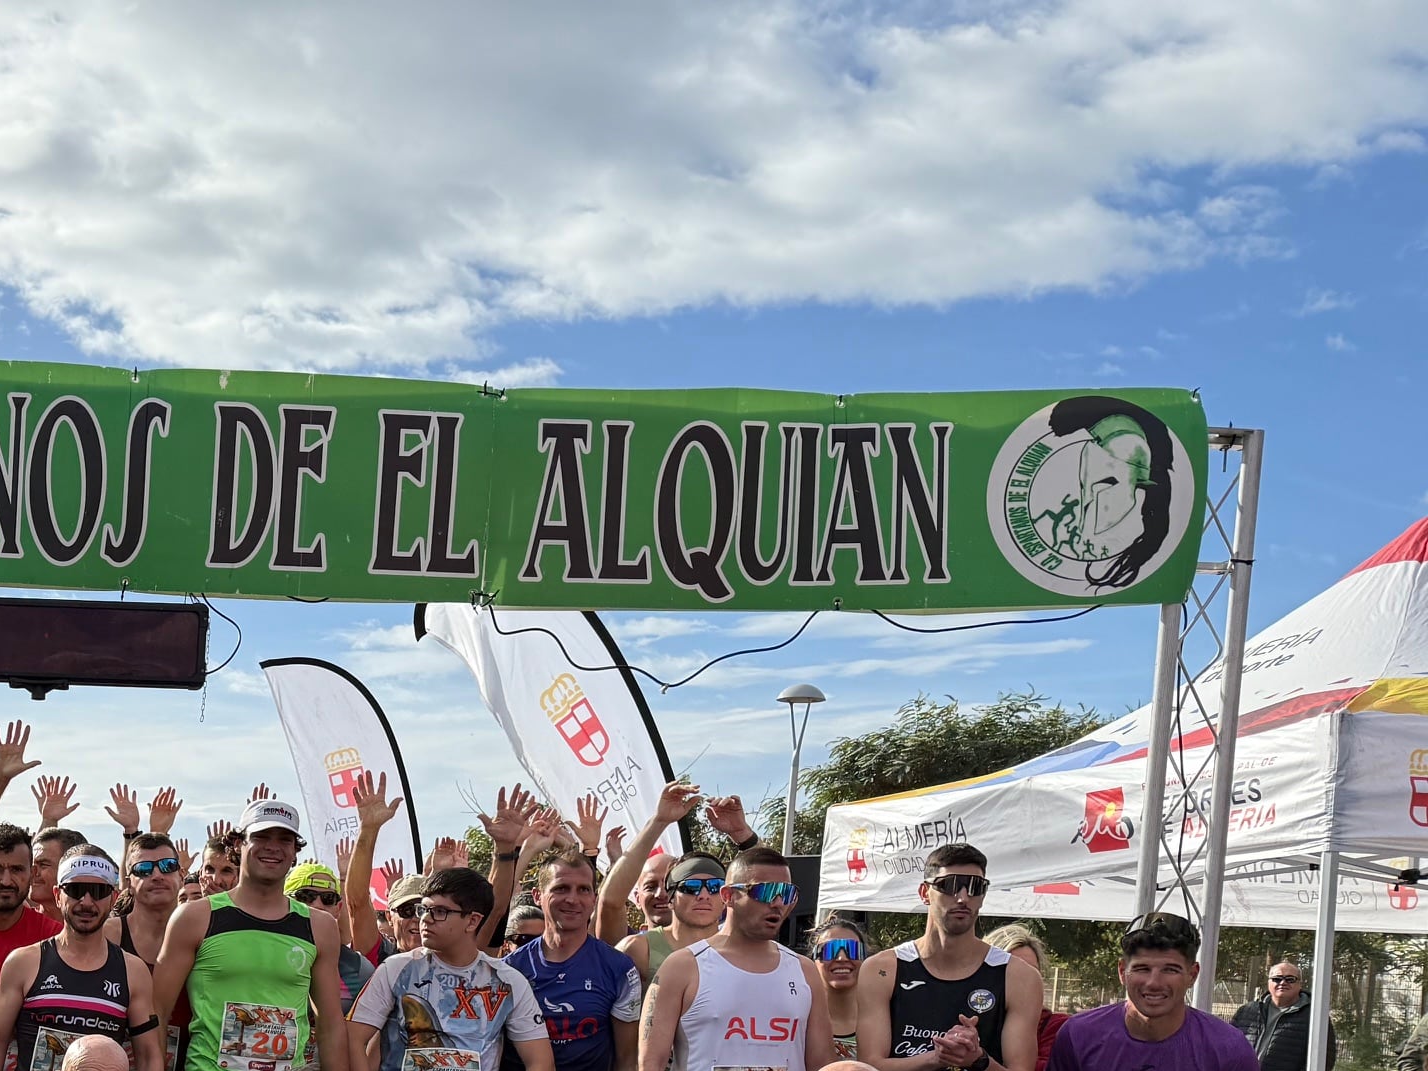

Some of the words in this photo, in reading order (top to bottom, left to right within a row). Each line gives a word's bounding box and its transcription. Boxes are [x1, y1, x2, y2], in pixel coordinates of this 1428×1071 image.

[1015, 442, 1053, 477] ALQUIAN
[1010, 477, 1029, 488] EL
[206, 400, 338, 573] DE
[368, 408, 488, 578] EL
[518, 418, 954, 603] ALQUIAN
[1008, 491, 1028, 502] DE
[1008, 506, 1047, 558] ESPARTANOS
[883, 812, 967, 853] ALMERÍA
[70, 859, 111, 873] KIPRUN
[450, 988, 510, 1021] XV
[724, 1017, 799, 1041] ALSI
[252, 1032, 288, 1056] 20
[432, 1052, 473, 1067] XV
